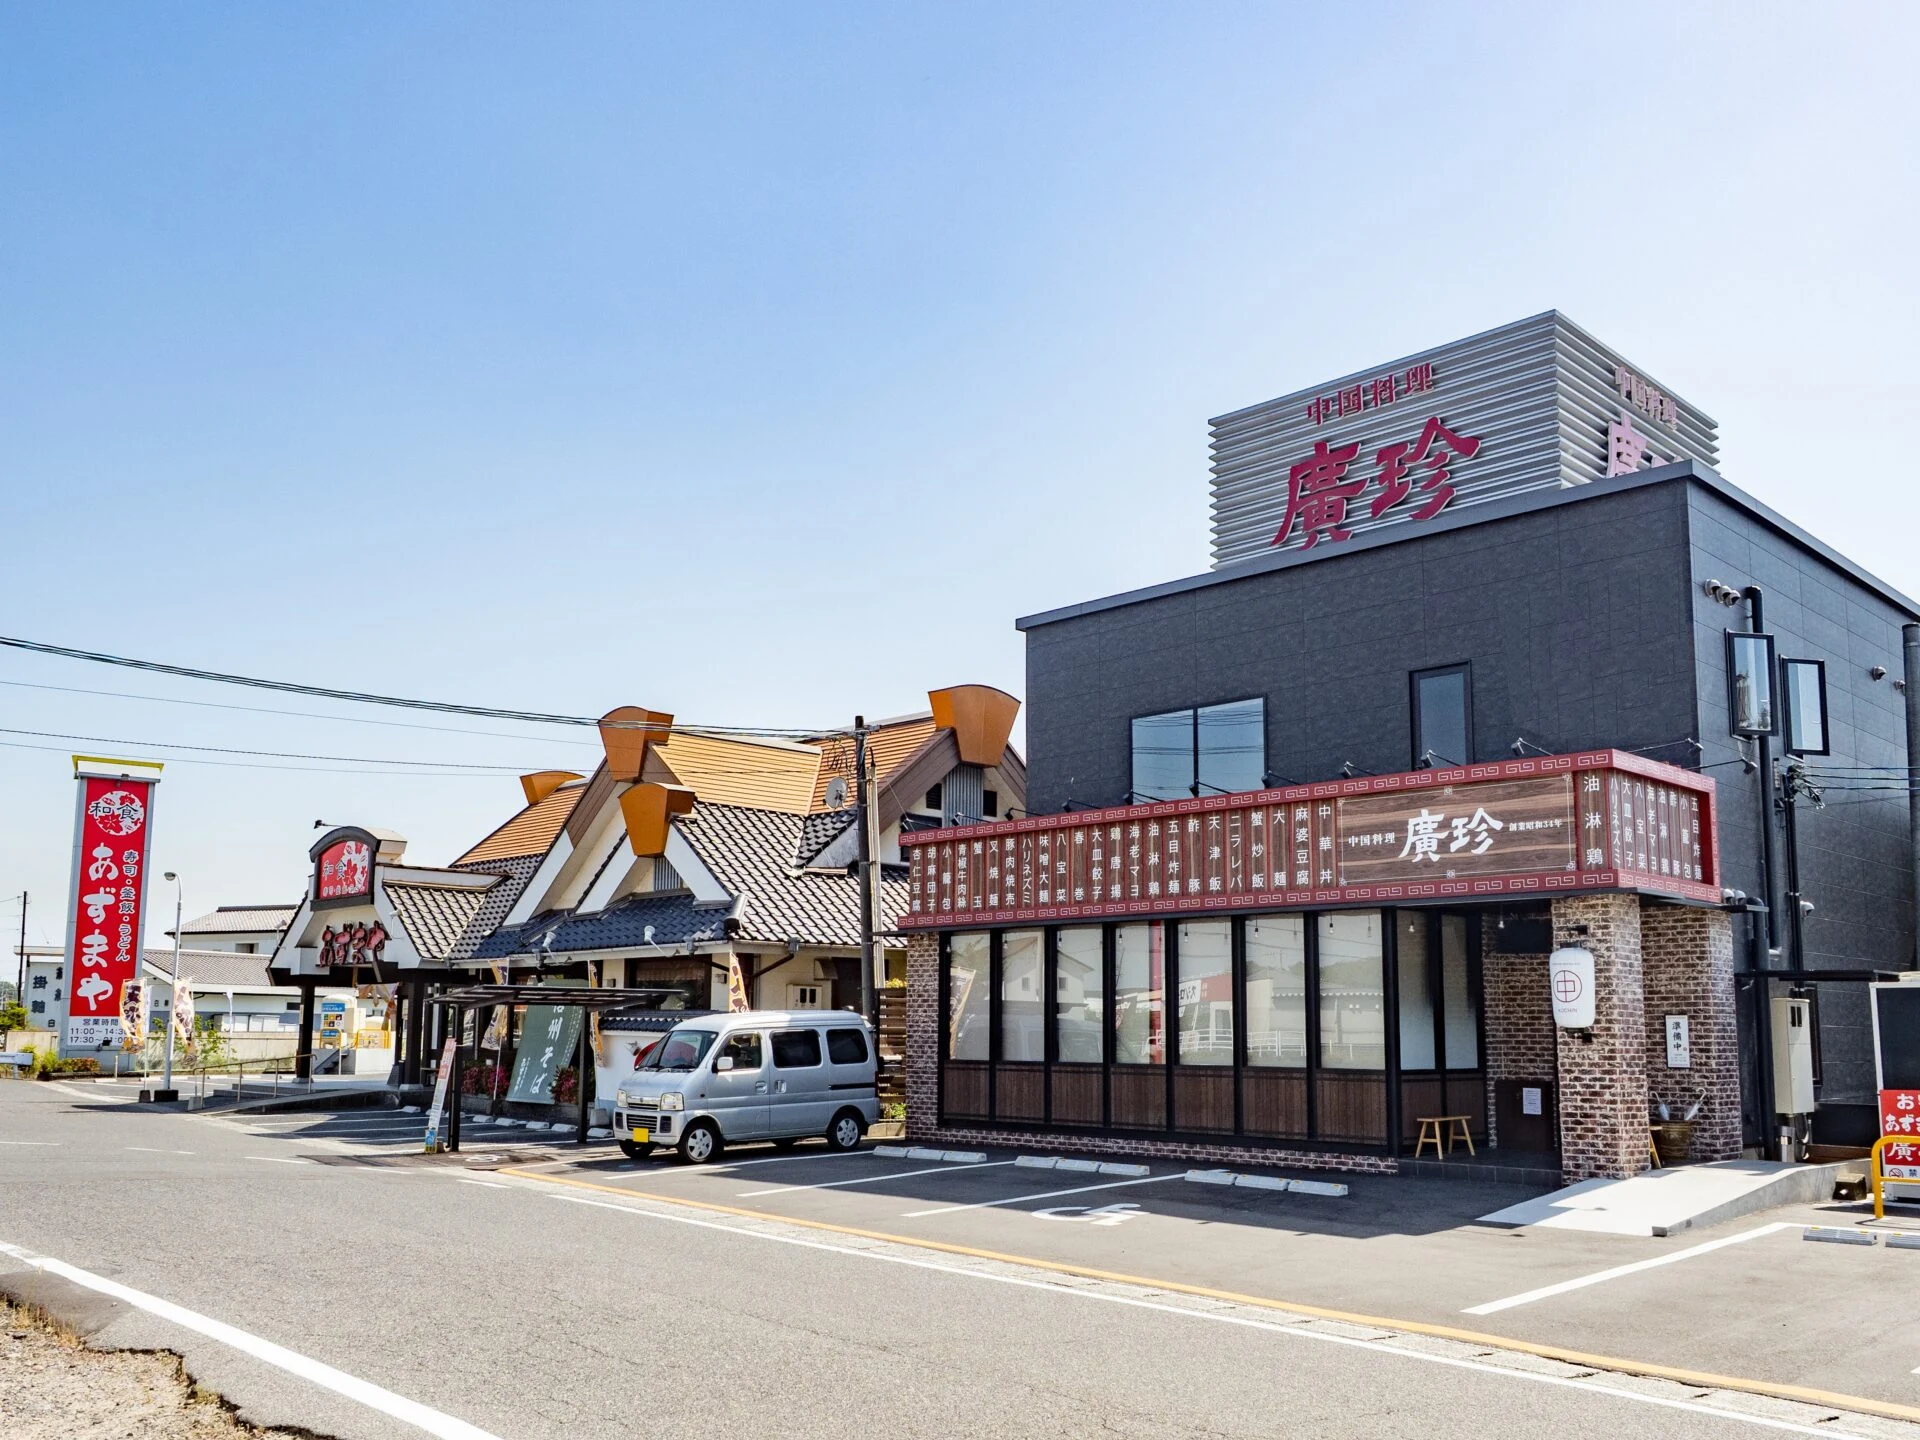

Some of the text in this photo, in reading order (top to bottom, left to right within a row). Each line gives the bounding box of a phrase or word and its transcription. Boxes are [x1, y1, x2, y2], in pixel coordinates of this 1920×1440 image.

[1306, 362, 1434, 426] 中国料理
[1269, 416, 1481, 552] 廣珍
[88, 801, 138, 821] 和食
[1295, 807, 1309, 886] 麻婆豆腐
[1318, 804, 1333, 884] 中華丼
[1348, 832, 1396, 848] 中国料理
[1399, 807, 1504, 864] 廣珍
[1583, 775, 1603, 865] 油淋鶏
[1610, 777, 1621, 864] ハリネズミ
[1622, 779, 1633, 867] 大皿餃子
[1635, 782, 1646, 870] 八宝菜
[1646, 785, 1657, 871] 海老マヨ
[912, 848, 921, 912] 杏仁豆腐
[927, 846, 936, 912] 胡麻団子
[973, 842, 983, 908] 蟹玉
[1005, 838, 1015, 906] 豚肉焼売
[1022, 838, 1032, 904] ハリネズミ
[1056, 833, 1067, 903] 八宝菜
[1074, 831, 1084, 901] 春巻
[1092, 828, 1102, 900] 大皿餃子
[1129, 825, 1140, 897] 海老マヨ
[1148, 823, 1160, 896] 油淋鶏
[1188, 819, 1200, 892] 酢豚
[1208, 816, 1221, 891] 天津飯
[1230, 815, 1242, 888] ニラレバ
[1251, 812, 1264, 888] 蟹炒飯
[76, 842, 119, 1011] あずまや
[115, 849, 140, 962] 寿司・釜飯・うどん
[82, 1018, 119, 1026] 営業時間
[1672, 1021, 1682, 1051] 準備中
[1885, 1114, 1920, 1132] あず
[1896, 1094, 1920, 1110] お
